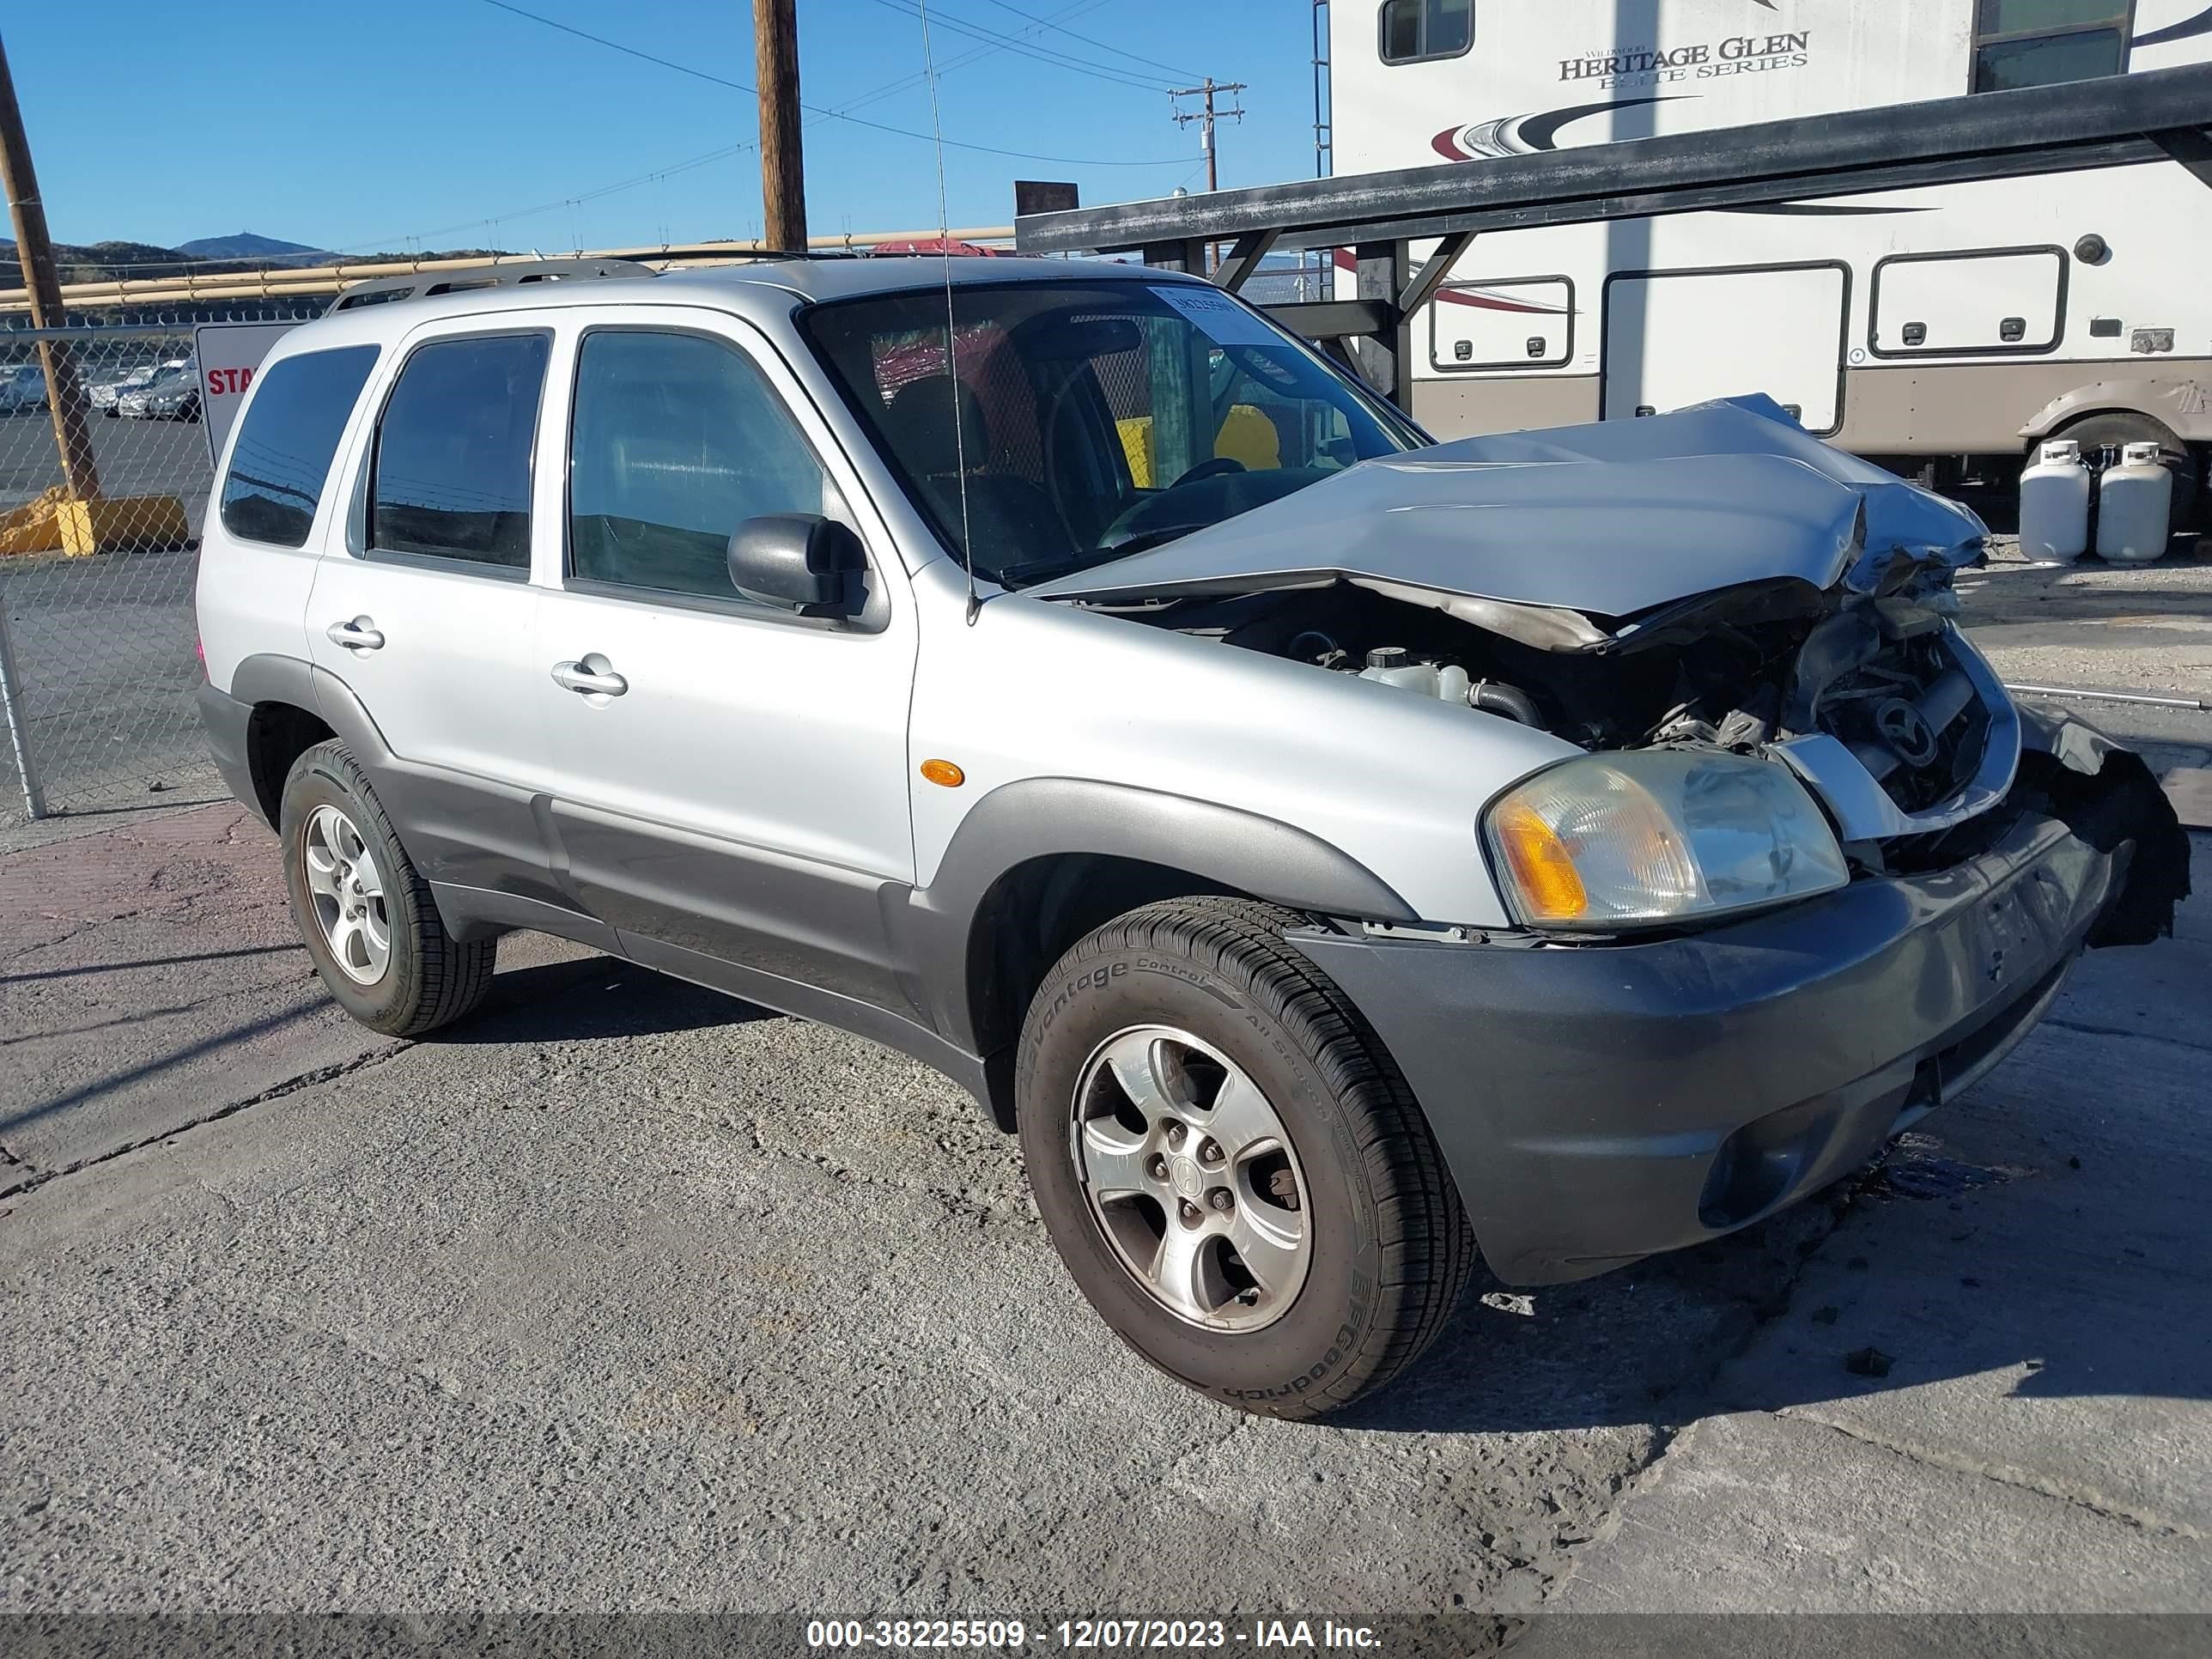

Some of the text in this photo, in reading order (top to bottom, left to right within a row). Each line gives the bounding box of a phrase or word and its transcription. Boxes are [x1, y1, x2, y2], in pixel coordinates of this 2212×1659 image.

[1559, 31, 1811, 82] HERITAGE GLEN
[1697, 52, 1808, 79] SERIES
[208, 367, 258, 395] STA
[1137, 958, 1206, 983] Control
[1245, 1015, 1271, 1037] All
[1223, 1268, 1373, 1401] BFGoodrich
